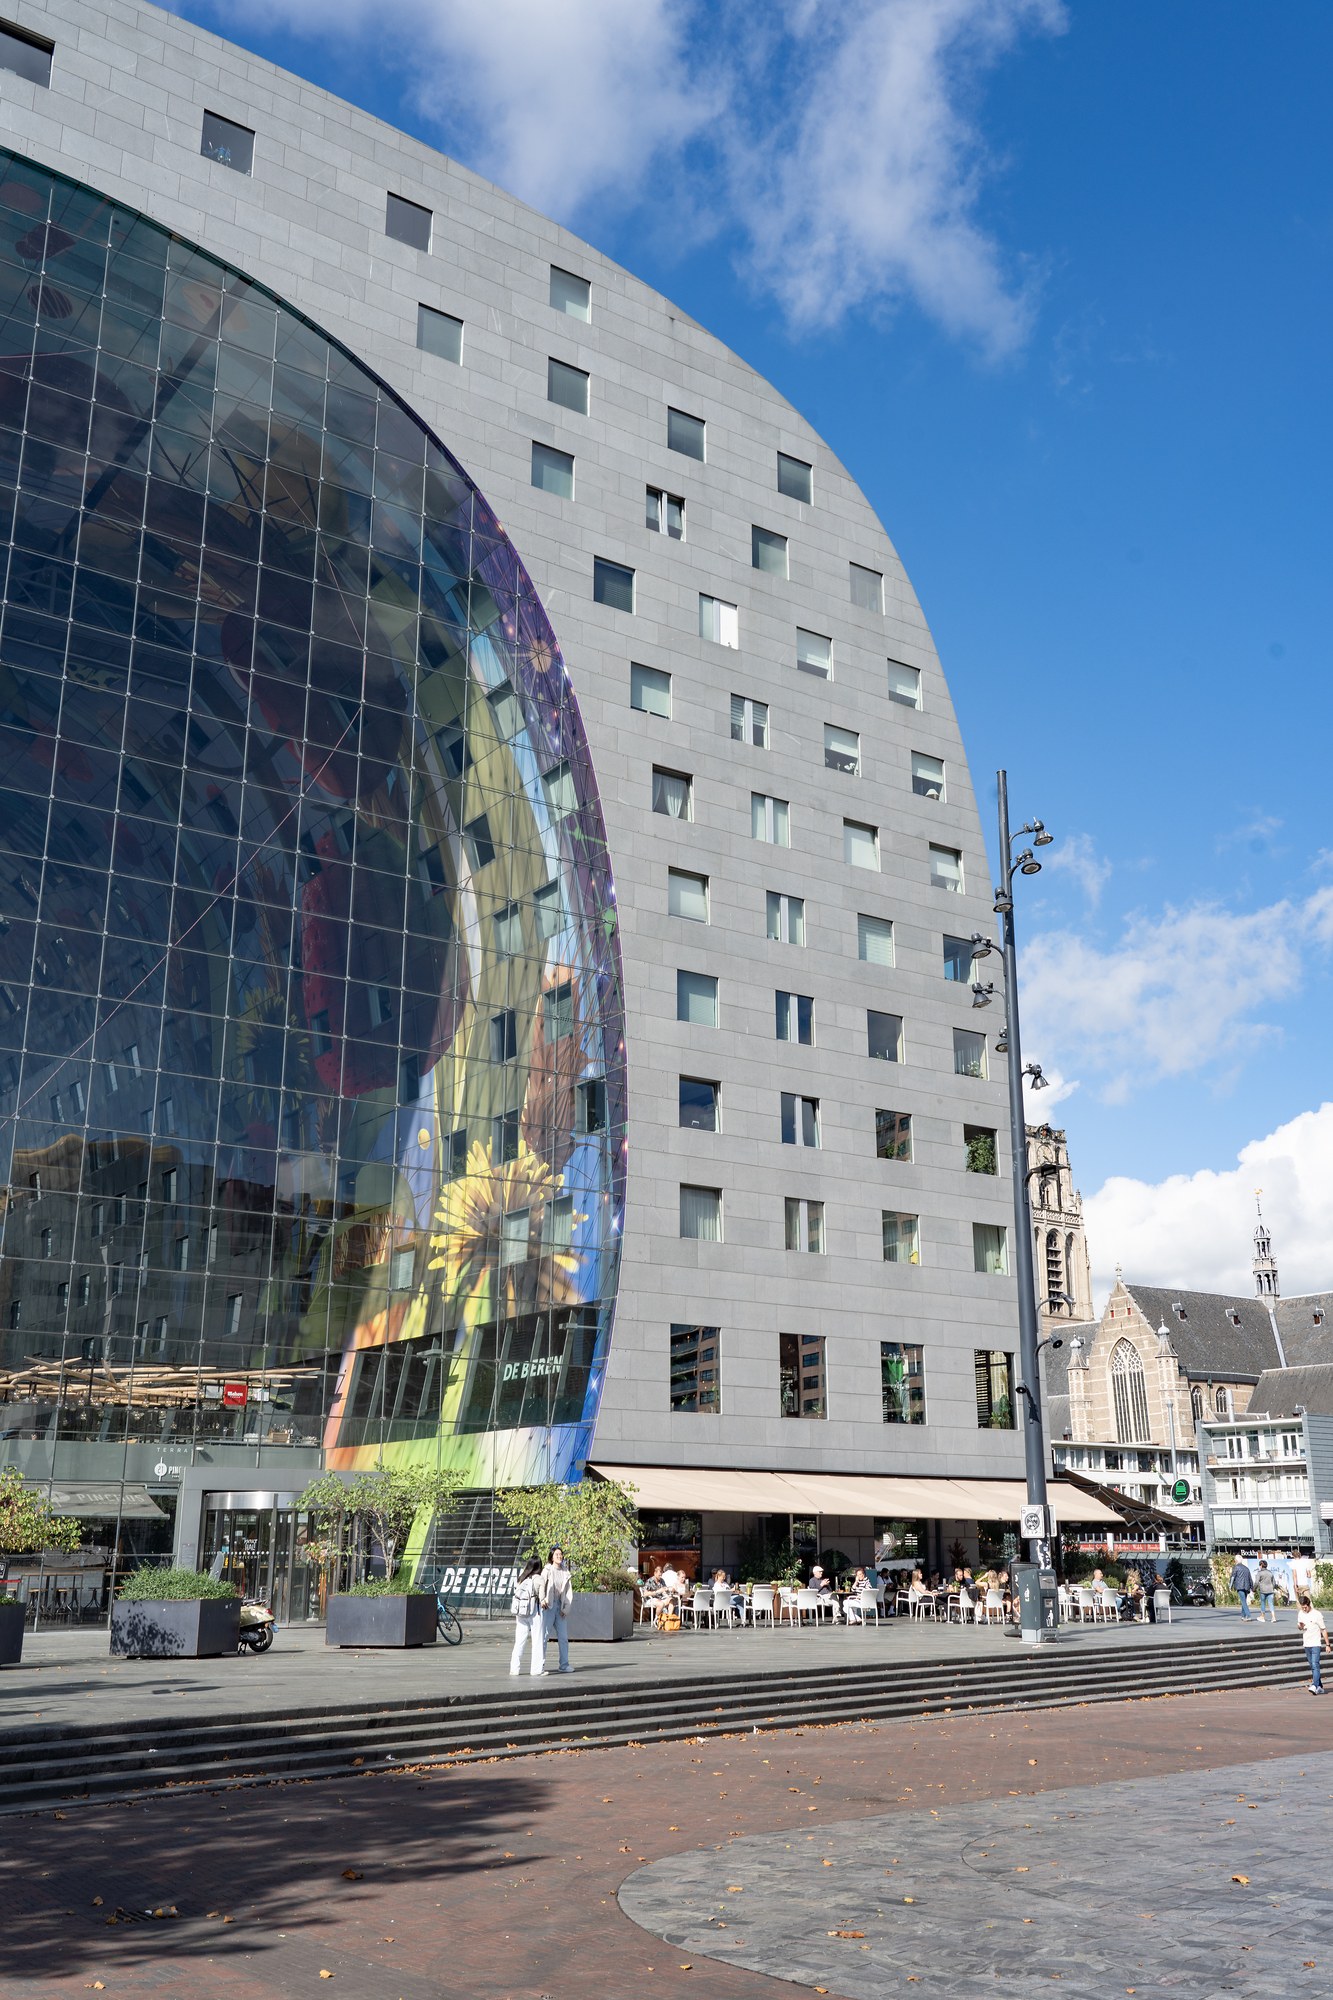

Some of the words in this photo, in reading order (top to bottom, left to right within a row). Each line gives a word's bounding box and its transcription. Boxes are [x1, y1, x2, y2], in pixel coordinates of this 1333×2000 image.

[503, 1362, 520, 1382] DE
[520, 1355, 563, 1379] BEREN
[440, 1567, 466, 1594] DE
[464, 1567, 524, 1595] BEREN
